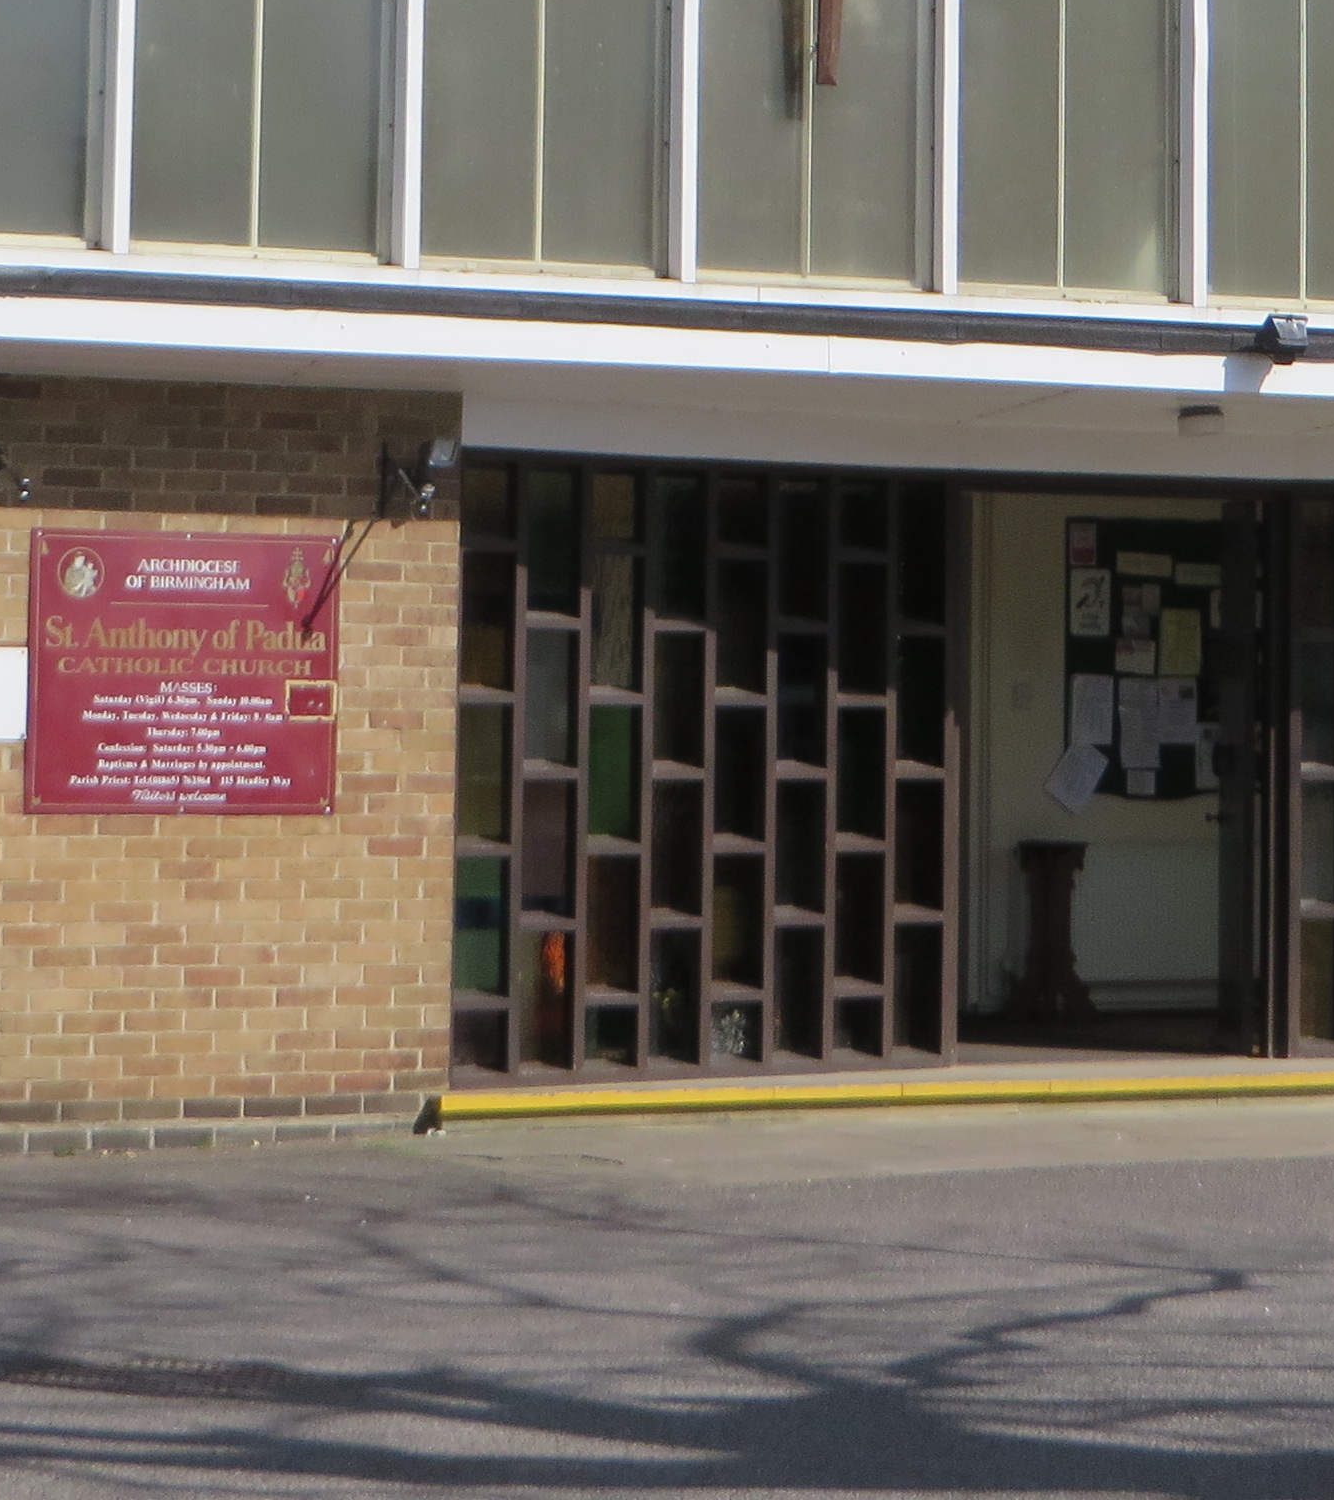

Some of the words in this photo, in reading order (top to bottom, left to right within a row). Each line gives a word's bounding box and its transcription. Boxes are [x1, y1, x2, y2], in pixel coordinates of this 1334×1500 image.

[137, 557, 241, 574] ARCHDIOCESE
[125, 575, 146, 589] OF
[150, 576, 251, 591] BIRMINGHAM
[45, 615, 80, 648] St.
[84, 617, 209, 656] Anthony
[212, 619, 241, 650] of
[245, 620, 327, 652] Padua
[57, 656, 194, 675] CATHOLIC
[202, 658, 313, 676] CHURCH
[160, 681, 218, 694] MASSES:
[94, 694, 132, 705] Saturday
[207, 695, 236, 706] Sunday
[162, 710, 207, 722] Wednesday
[98, 758, 138, 770] Baptisms
[70, 774, 99, 785] Parish
